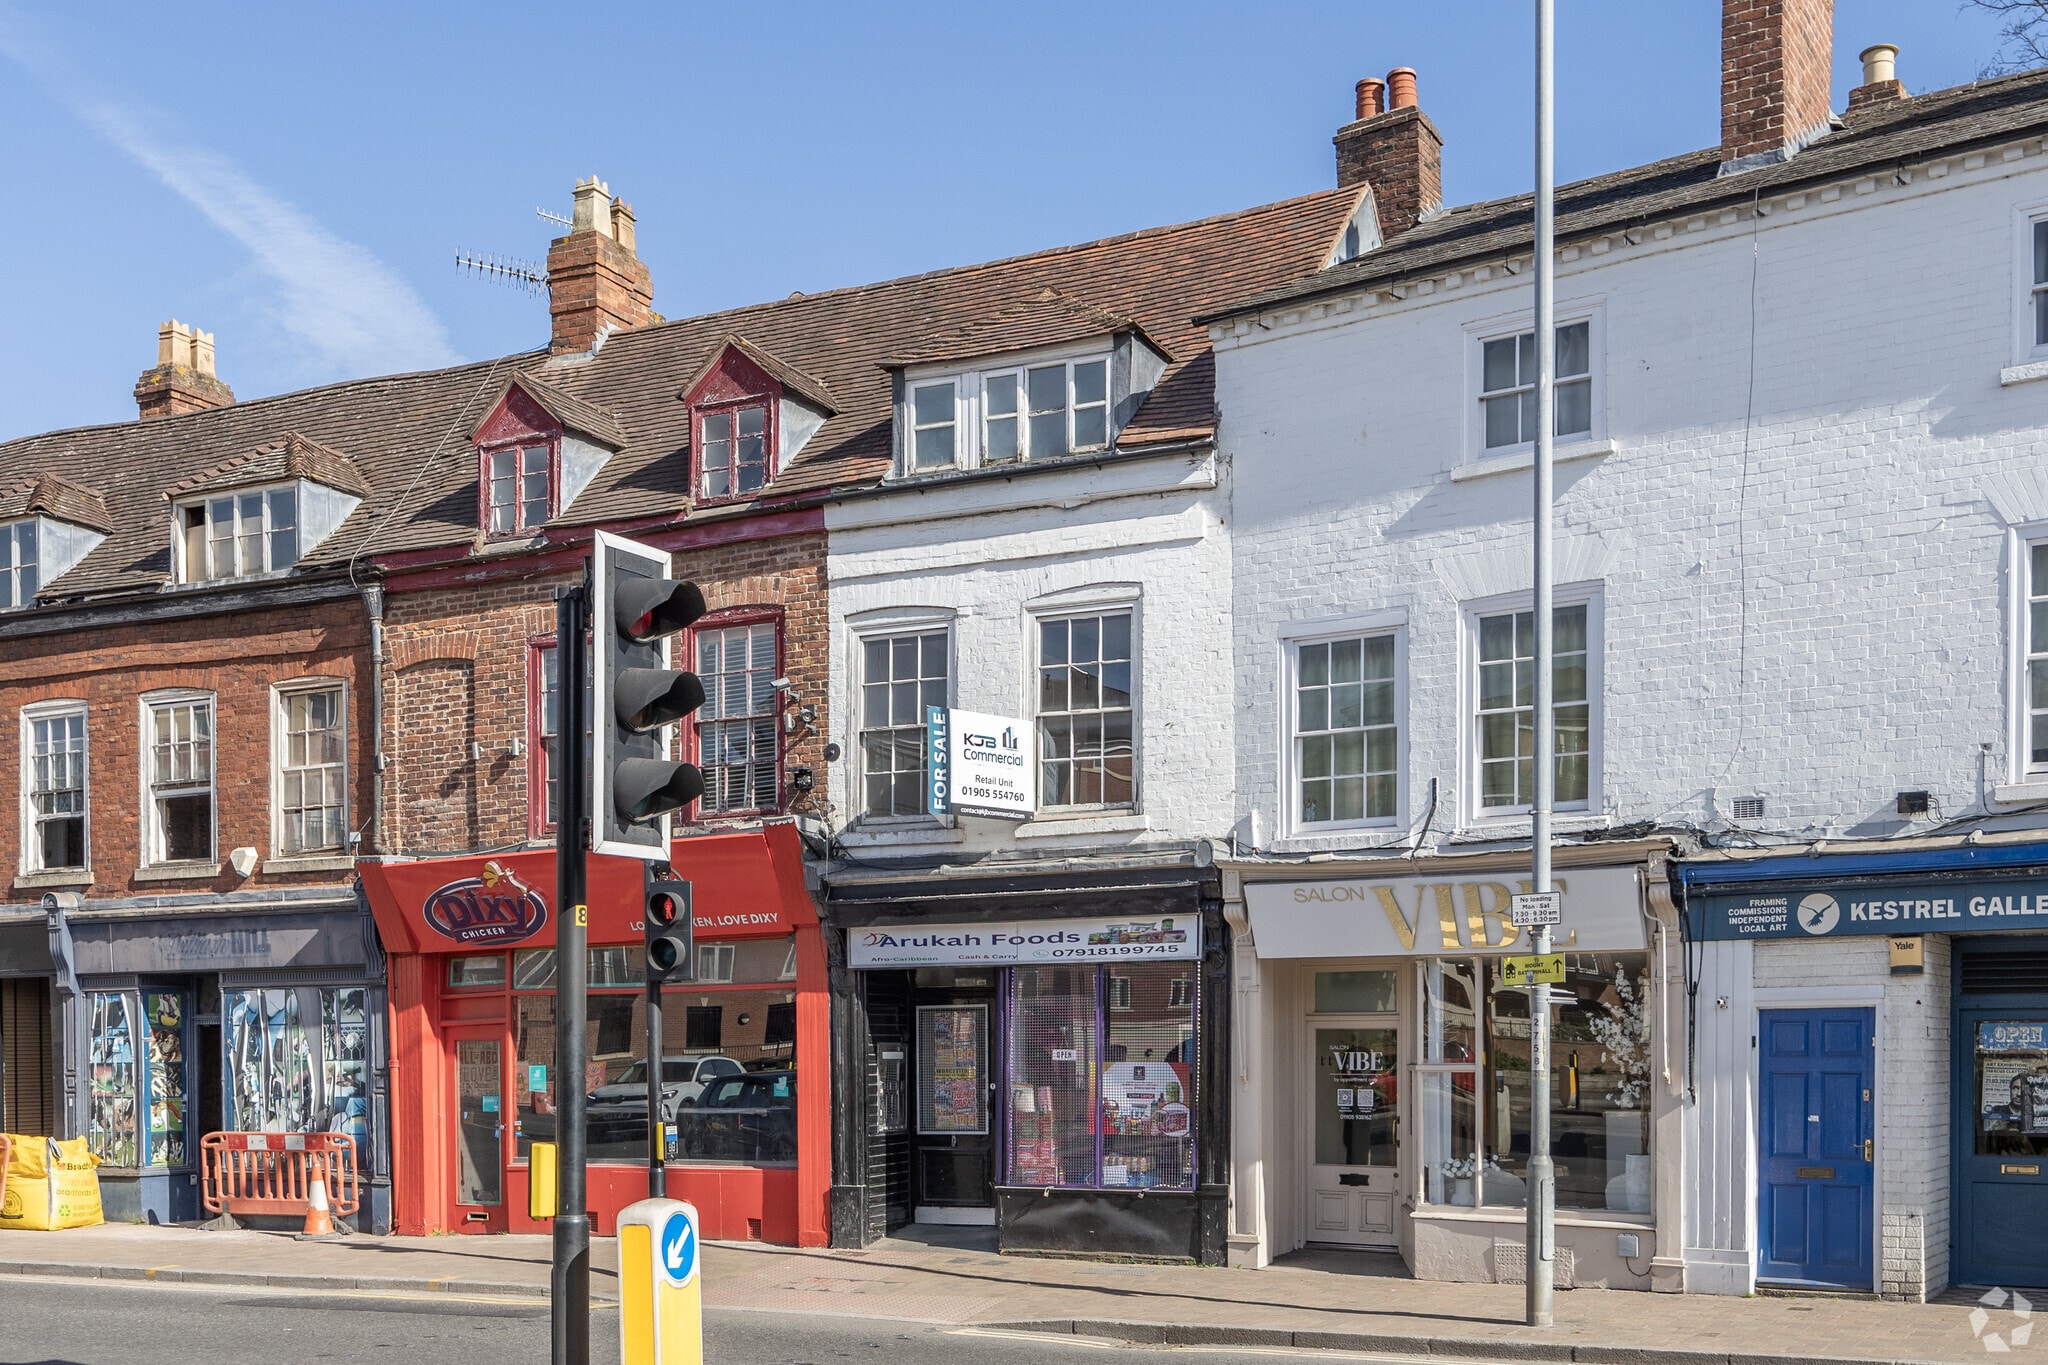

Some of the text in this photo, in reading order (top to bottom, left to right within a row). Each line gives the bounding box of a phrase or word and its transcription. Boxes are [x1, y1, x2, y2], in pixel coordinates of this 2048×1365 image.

[933, 712, 947, 810] FOR SALE
[963, 748, 1023, 767] Commercial
[975, 774, 1013, 788] Retail Unit
[962, 786, 1024, 802] 01905 554760
[1293, 886, 1365, 902] SALON
[436, 886, 527, 931] Dixy
[1749, 898, 1788, 907] FRAMING
[1850, 895, 2048, 921] KESTREL GALLE
[578, 907, 587, 923] 8
[1728, 906, 1788, 916] COMMISSIONS
[717, 915, 749, 926] LOVE
[750, 913, 778, 924] DIXY
[1728, 915, 1788, 925] INDEPENDENT
[462, 926, 506, 939] CHICKEN
[1739, 924, 1787, 934] LOCAL ART
[879, 932, 1080, 947] Arukah Foods
[1894, 942, 1915, 950] Yale
[1052, 945, 1179, 957] 07918199745
[1993, 1026, 2043, 1042] OPEN
[1333, 1052, 1383, 1070] VIBE
